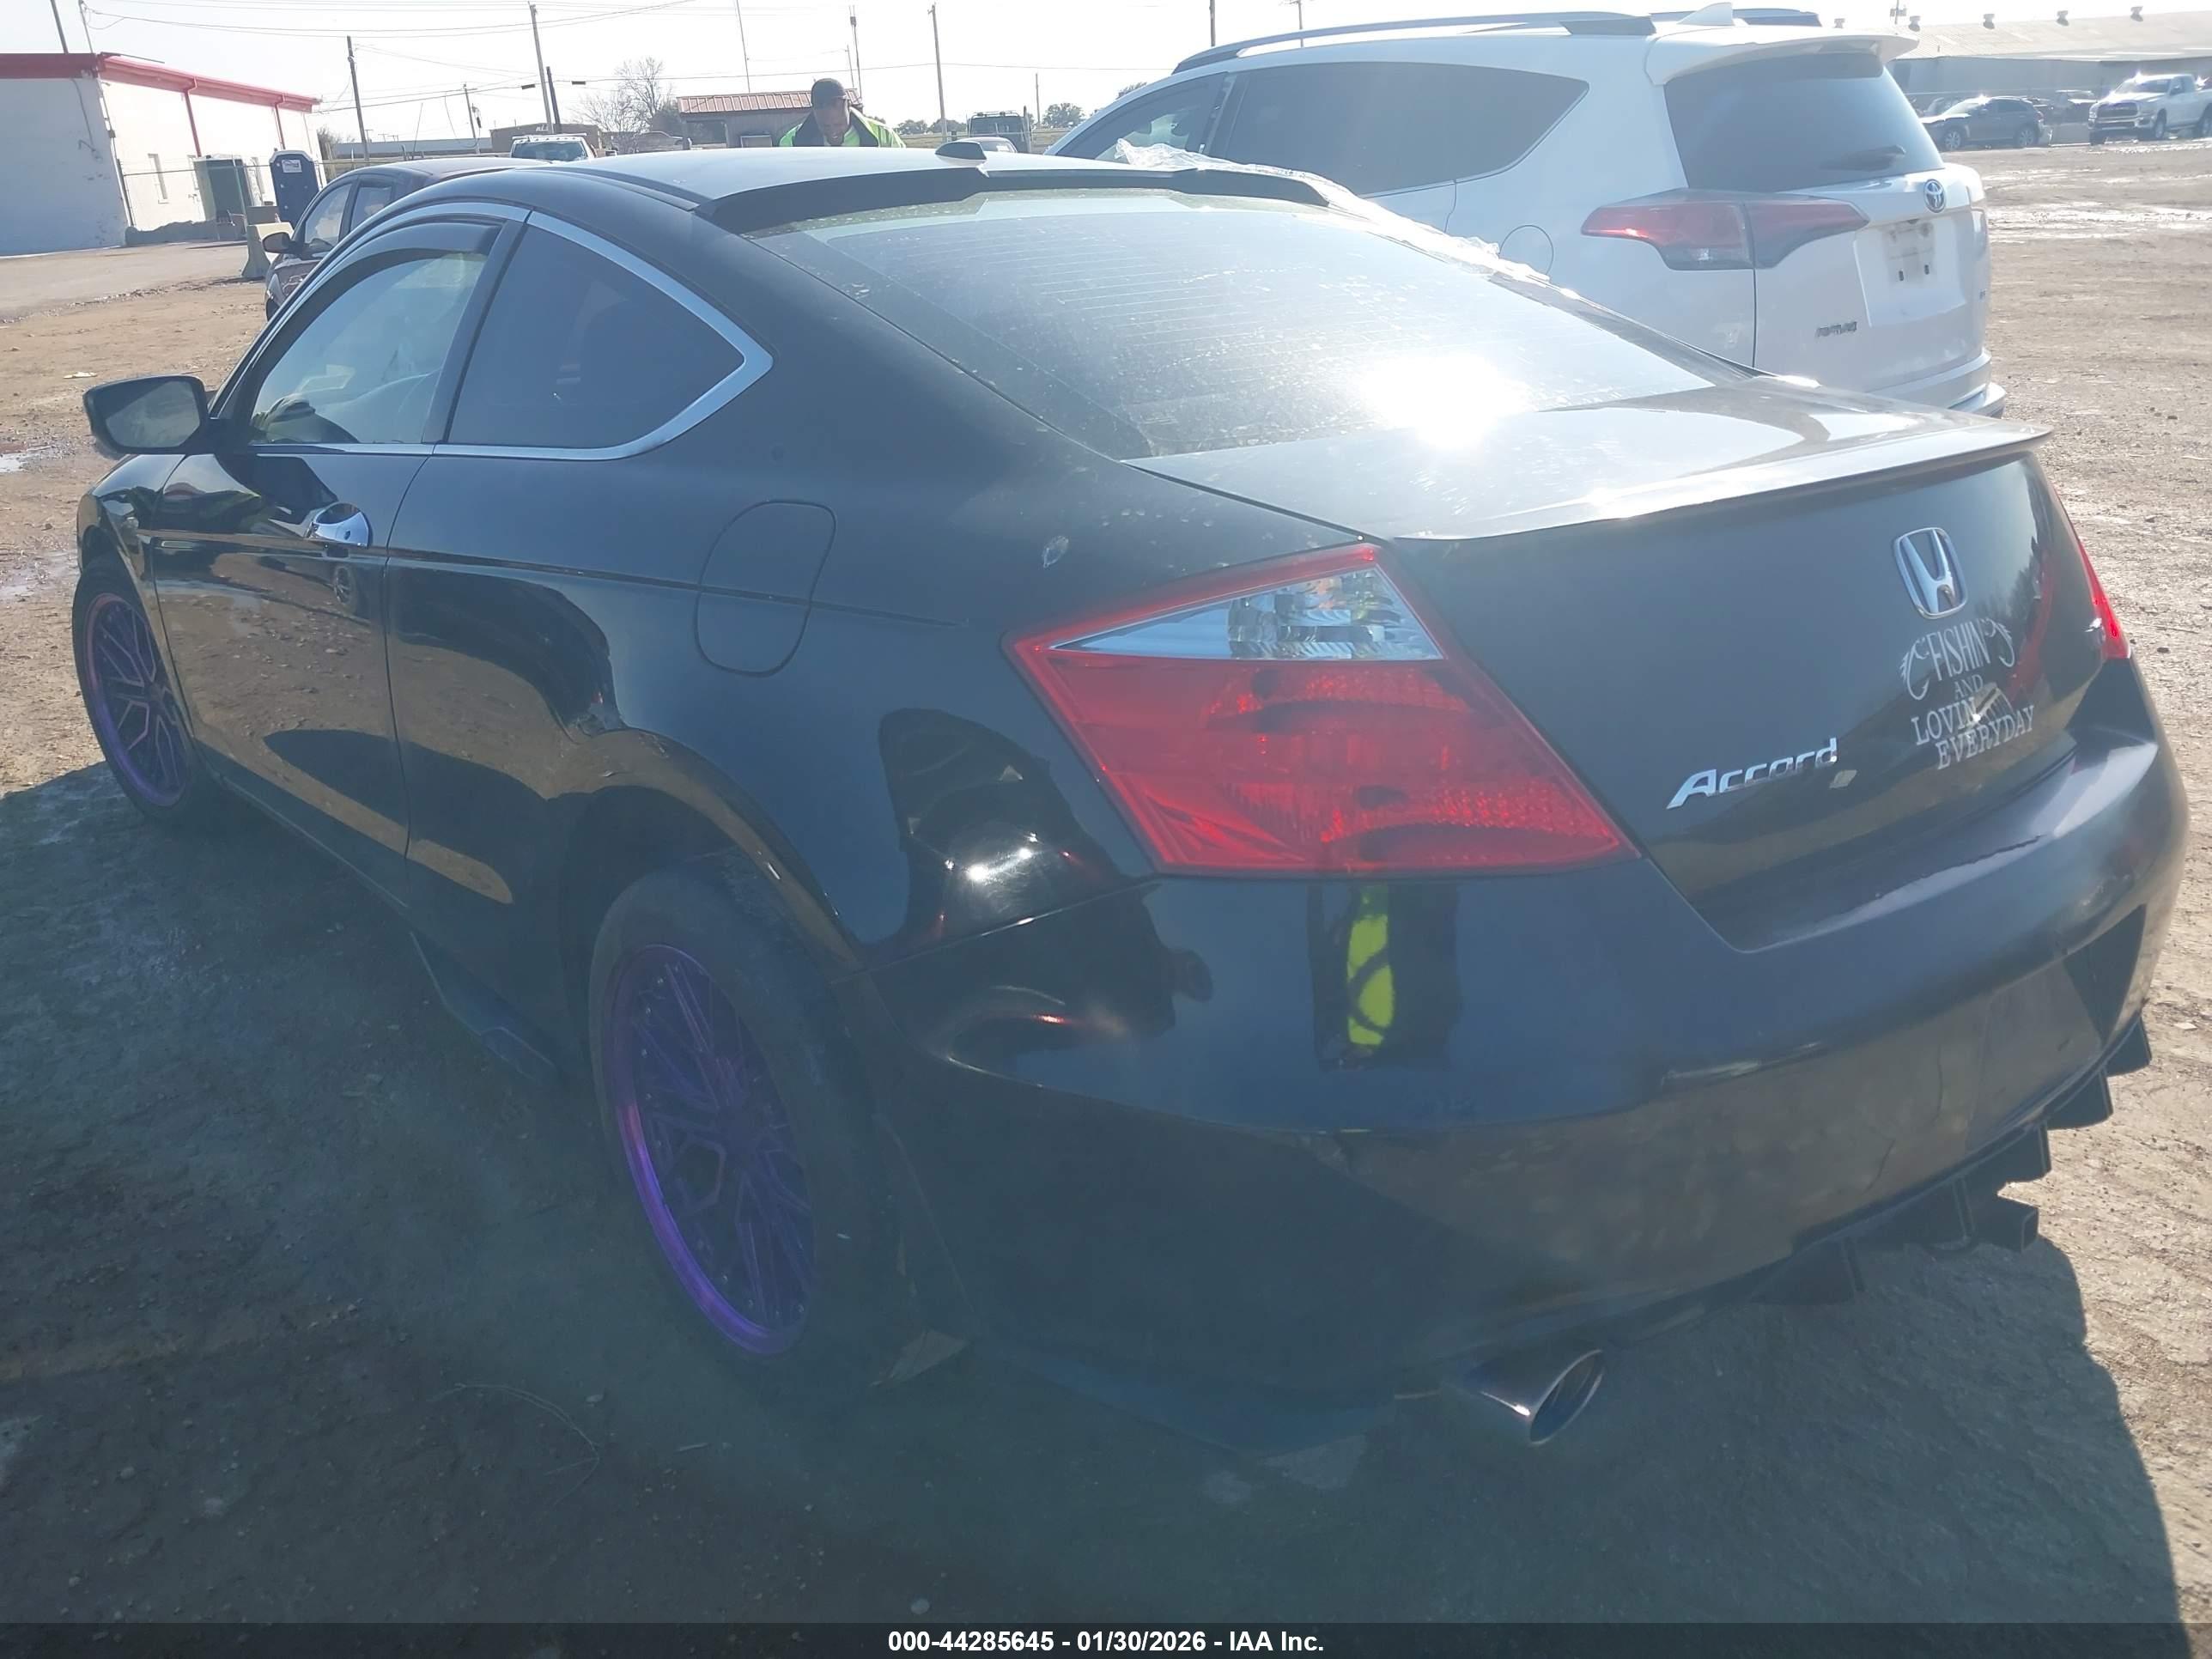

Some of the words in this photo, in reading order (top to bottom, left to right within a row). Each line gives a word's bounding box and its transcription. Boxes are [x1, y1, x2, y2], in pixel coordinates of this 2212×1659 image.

[1954, 674, 1984, 700] AND
[1911, 696, 1978, 745] LOVIN
[1935, 705, 2034, 770] EVERYDAY
[1666, 738, 1838, 809] Accord
